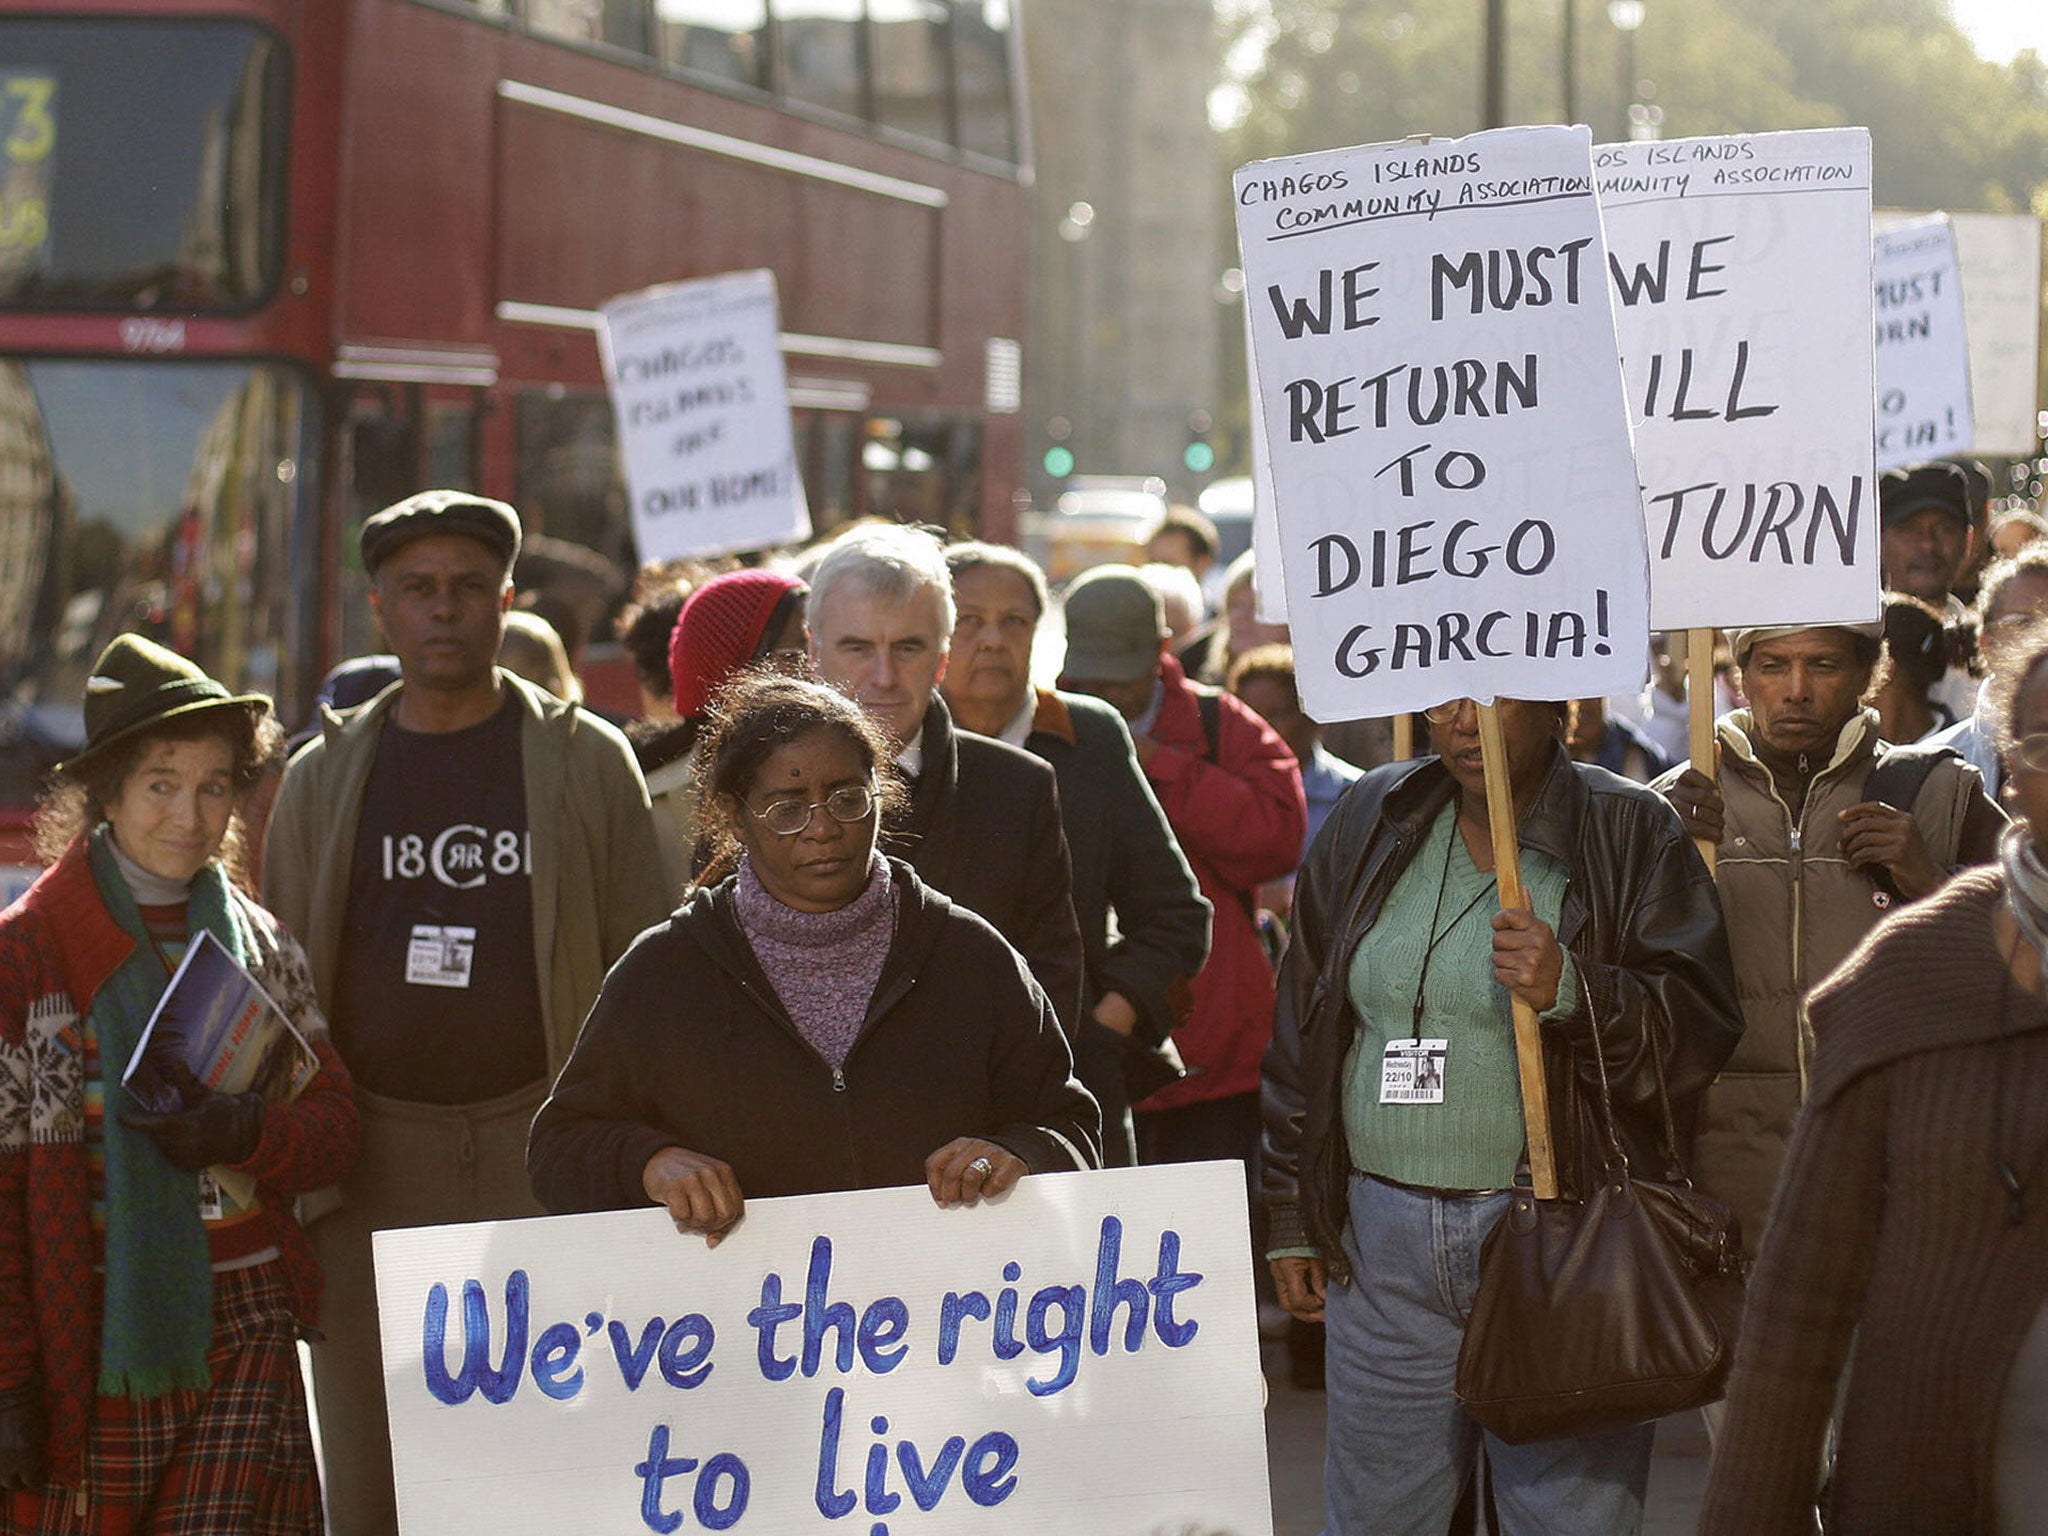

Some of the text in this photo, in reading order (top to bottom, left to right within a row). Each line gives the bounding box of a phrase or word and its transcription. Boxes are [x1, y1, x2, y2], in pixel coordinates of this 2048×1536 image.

[1241, 153, 1481, 205] CHAGOS ISLANDS
[1597, 164, 1853, 198] MUNITY ASSOCIATION
[1648, 141, 1755, 167] ISLANDS
[1276, 176, 1591, 230] COMMUNITY ASSOCIATION
[1267, 237, 1593, 340] WE MUST
[1608, 235, 1734, 306] WE
[1284, 354, 1538, 444] RETURN
[1620, 341, 1780, 421] ILL
[1373, 444, 1487, 497] TO
[1307, 519, 1556, 598] DIEGO
[1640, 476, 1862, 566] TURN
[1334, 589, 1613, 678] GARCIA!
[1385, 1071, 1412, 1082] 22/10
[423, 1215, 1203, 1405] We've the right
[634, 1387, 1019, 1534] to live
